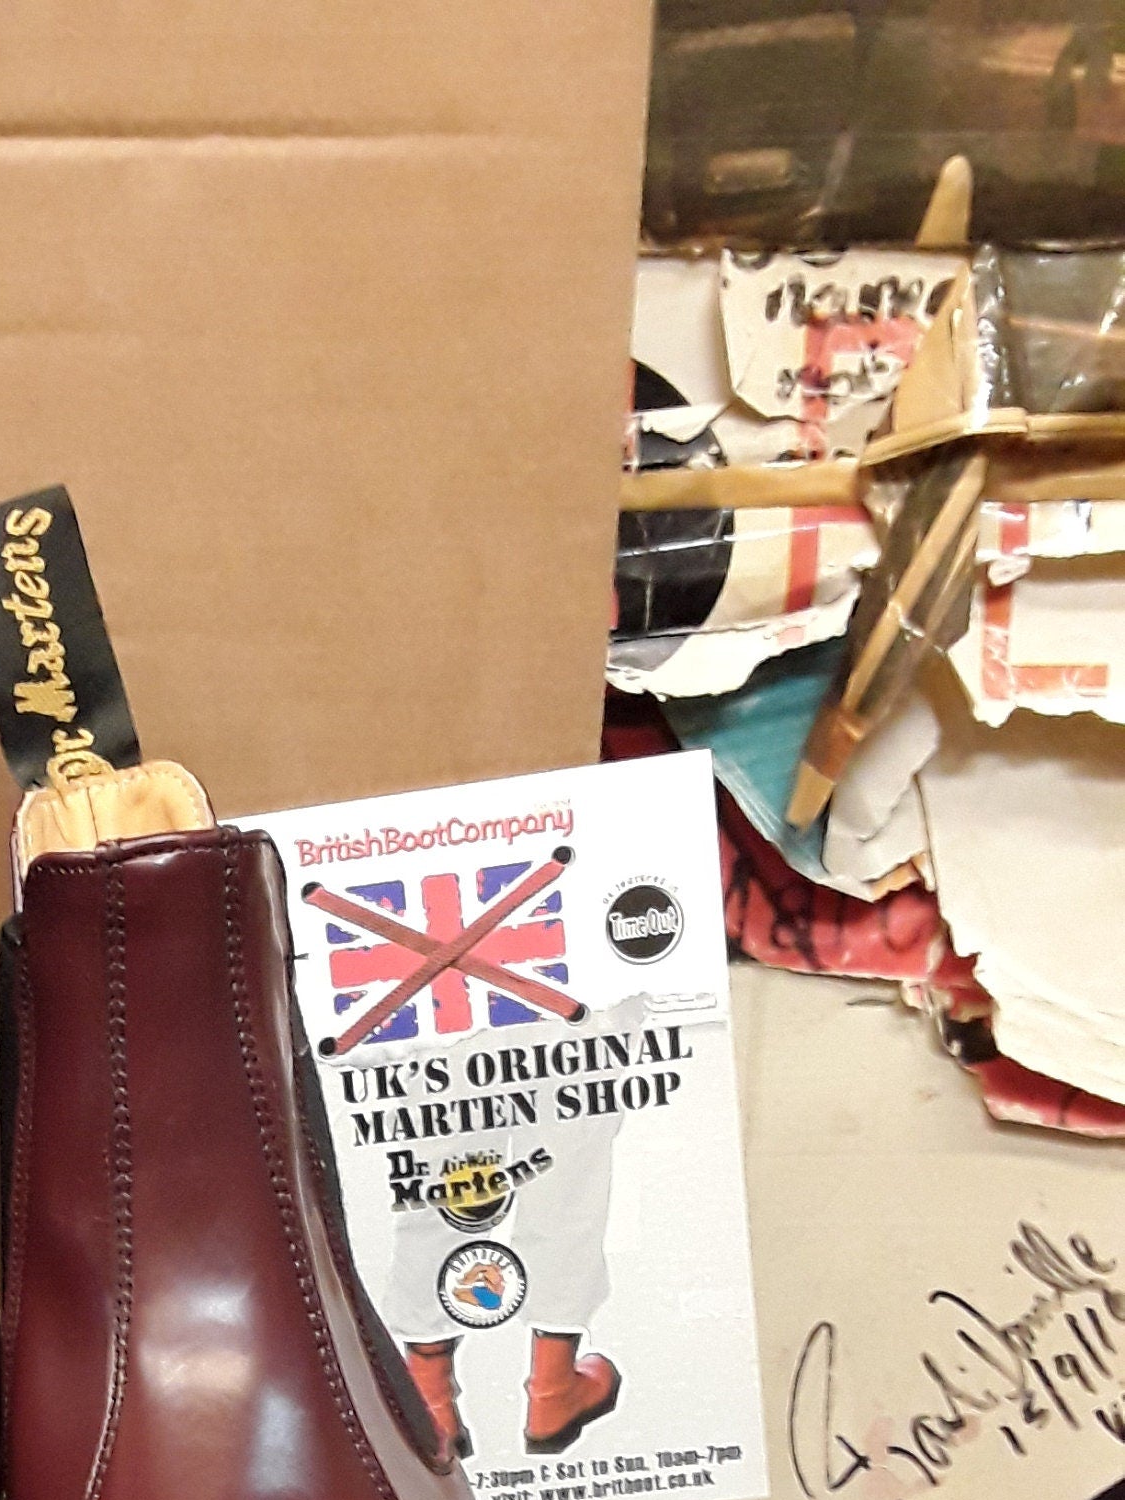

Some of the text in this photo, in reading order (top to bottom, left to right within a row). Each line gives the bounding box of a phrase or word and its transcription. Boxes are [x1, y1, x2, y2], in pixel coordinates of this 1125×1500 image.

[0, 506, 79, 723] Martens
[339, 1025, 693, 1104] UK'S ORIGINAL
[351, 1071, 681, 1147] MARTEN SHOP
[389, 1147, 554, 1212] Martens
[592, 1459, 609, 1476] to
